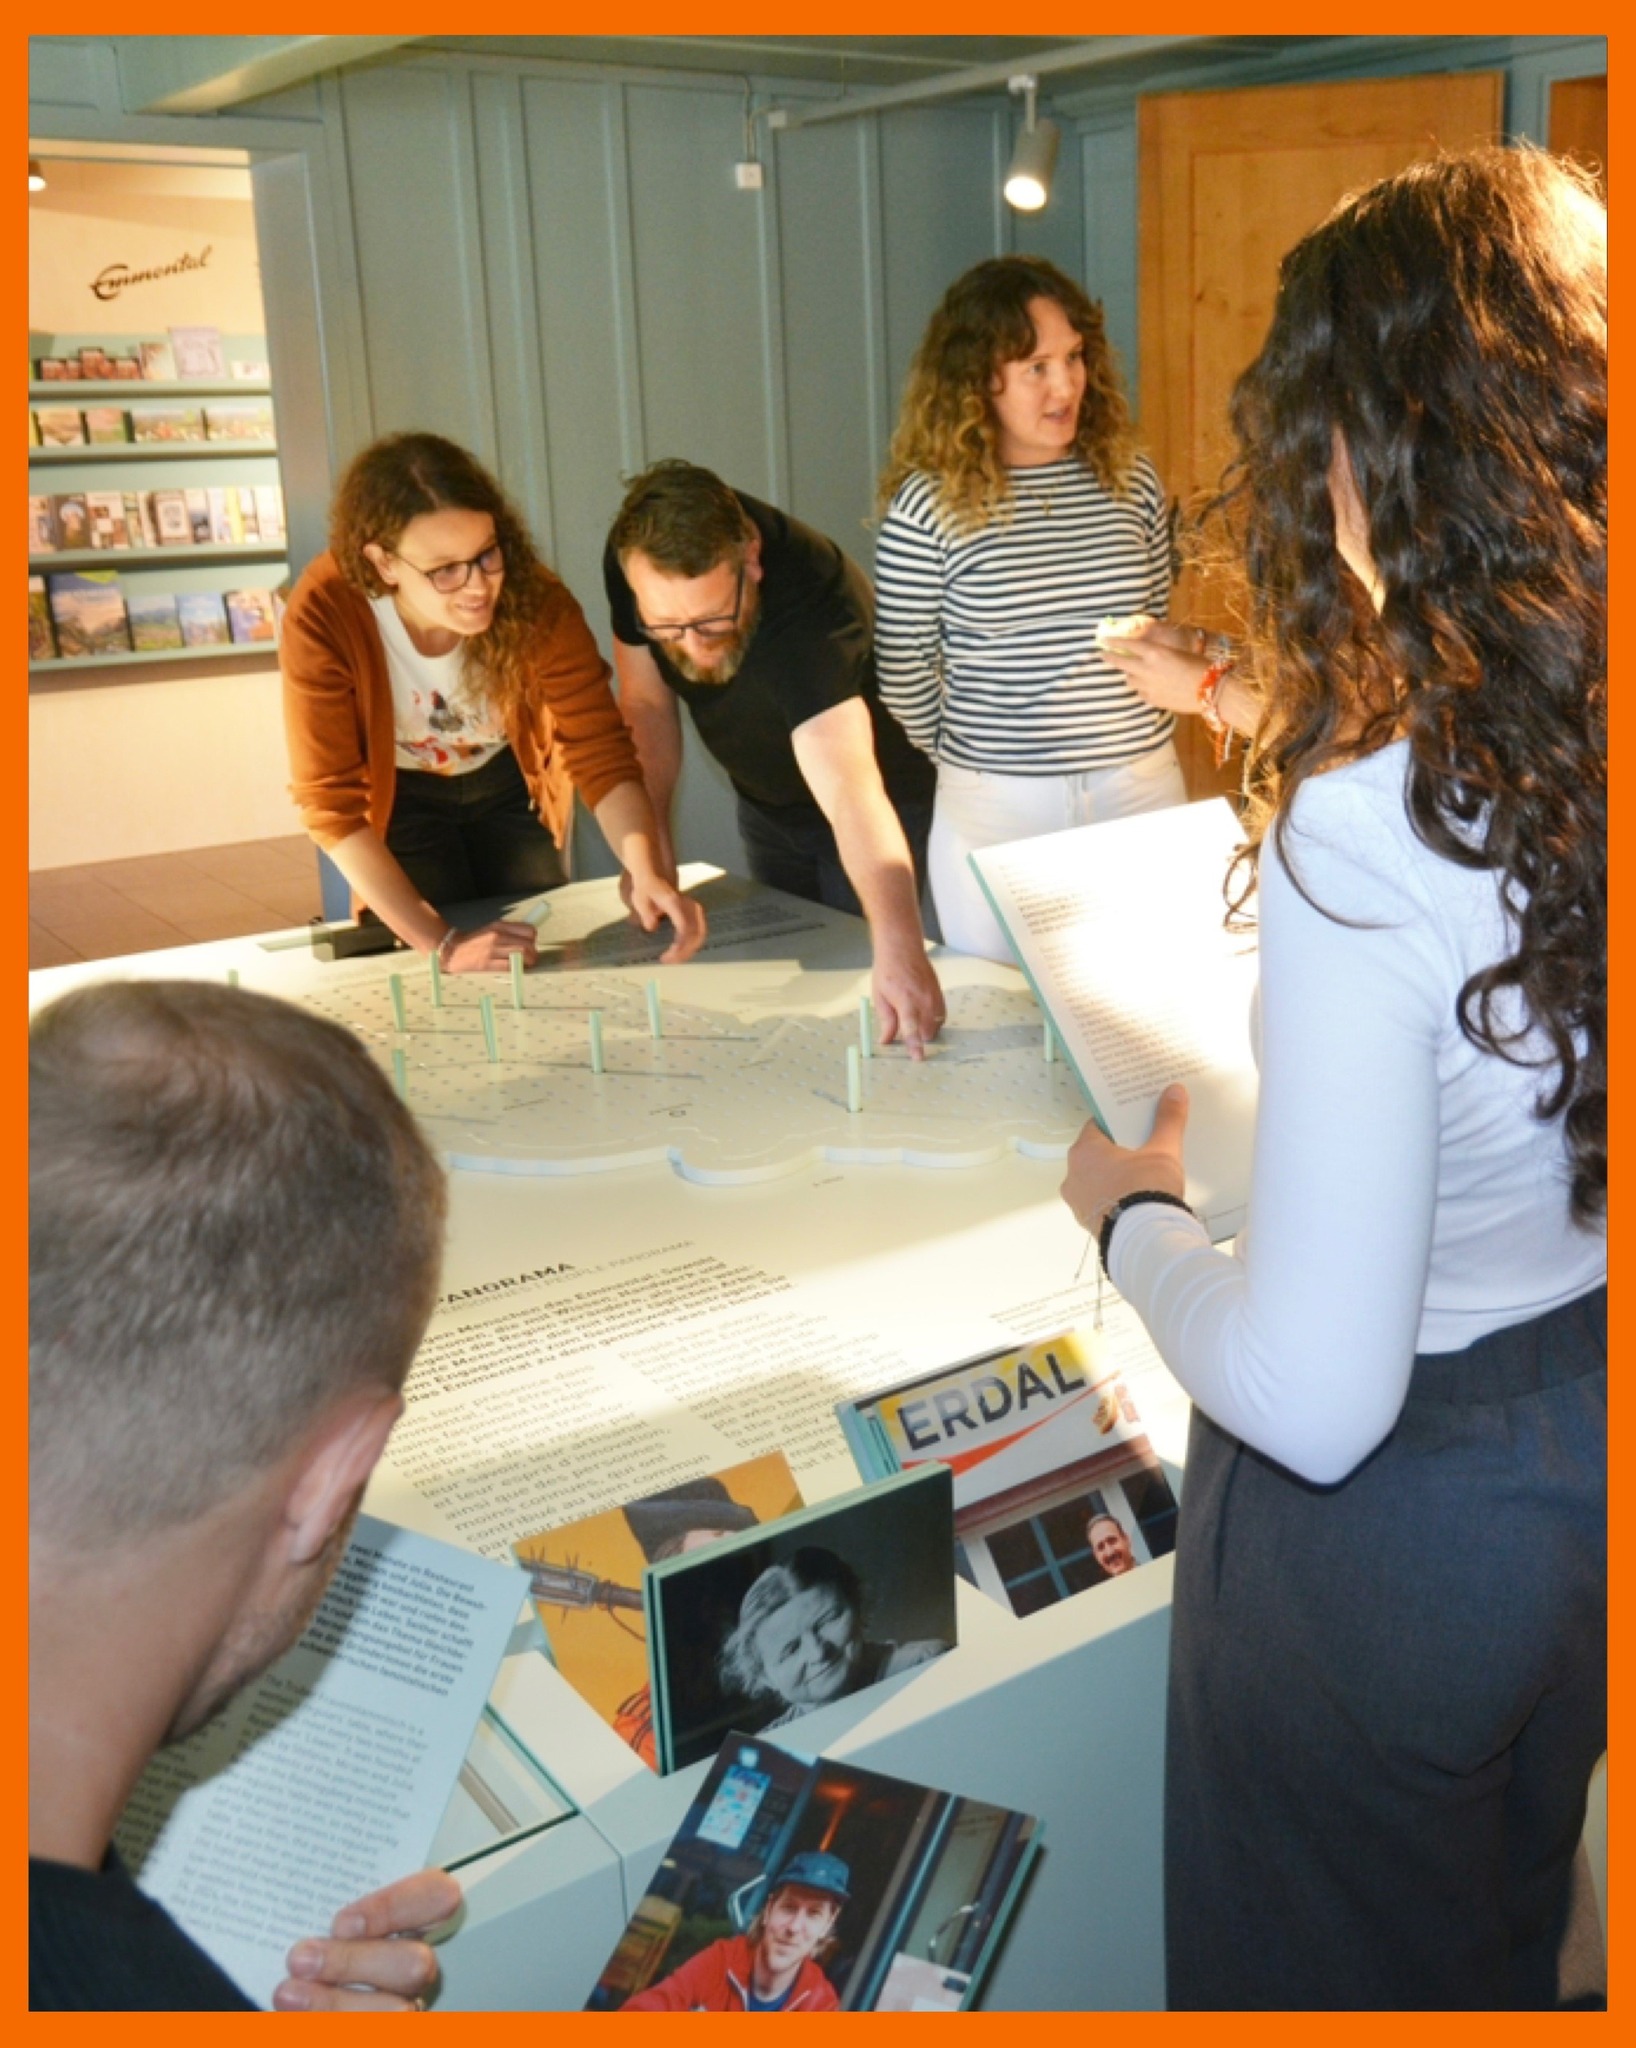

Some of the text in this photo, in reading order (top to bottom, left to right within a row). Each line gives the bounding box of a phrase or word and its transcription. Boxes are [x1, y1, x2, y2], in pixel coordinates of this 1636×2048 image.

[90, 244, 211, 301] Emmental
[442, 1361, 533, 1393] Emmental
[897, 1353, 1086, 1451] ERDAL
